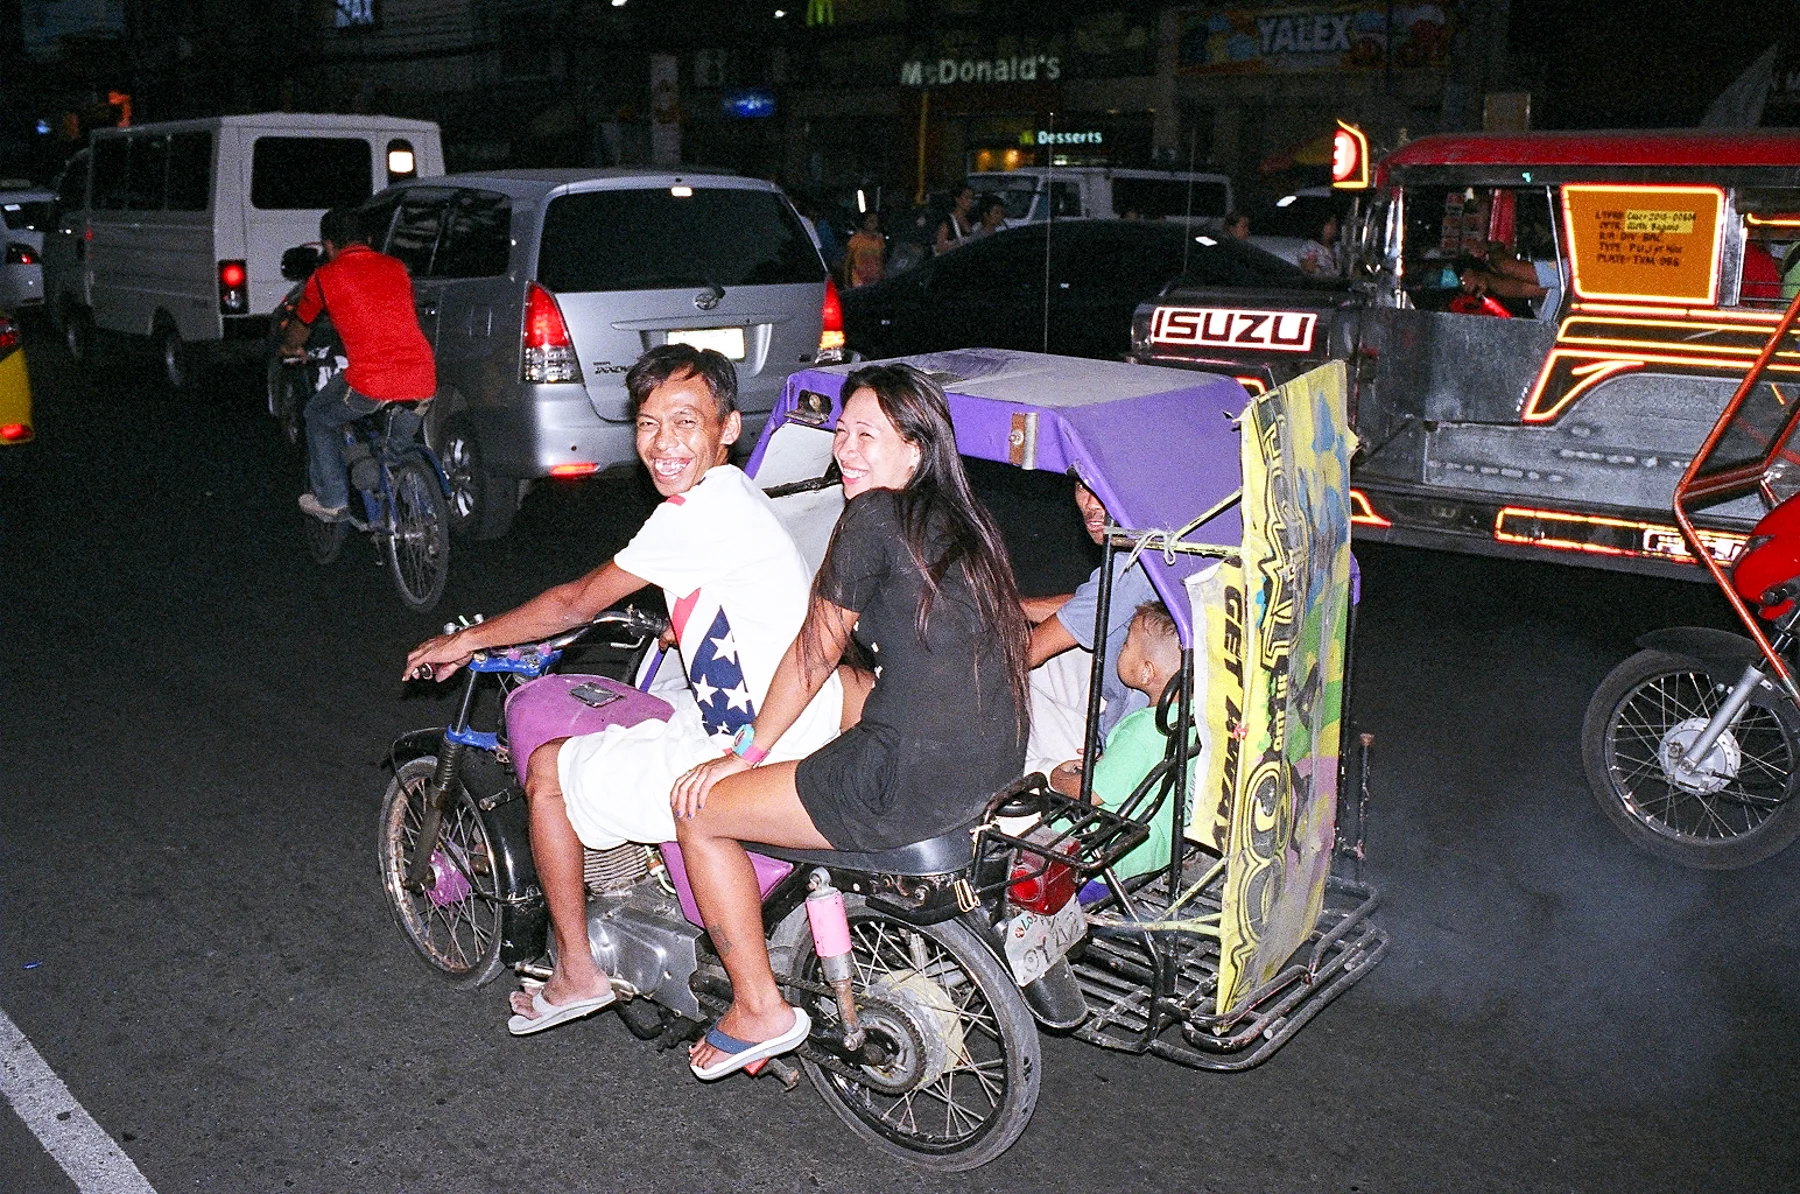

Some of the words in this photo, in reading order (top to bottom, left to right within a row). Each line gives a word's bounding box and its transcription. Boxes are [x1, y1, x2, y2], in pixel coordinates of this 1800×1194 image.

[1256, 14, 1351, 53] YALEX
[900, 54, 1061, 85] McDonald's
[1037, 130, 1103, 145] Desserts
[1153, 309, 1310, 346] ISUZU
[1223, 585, 1244, 690] GET
[1211, 693, 1243, 851] AWAY
